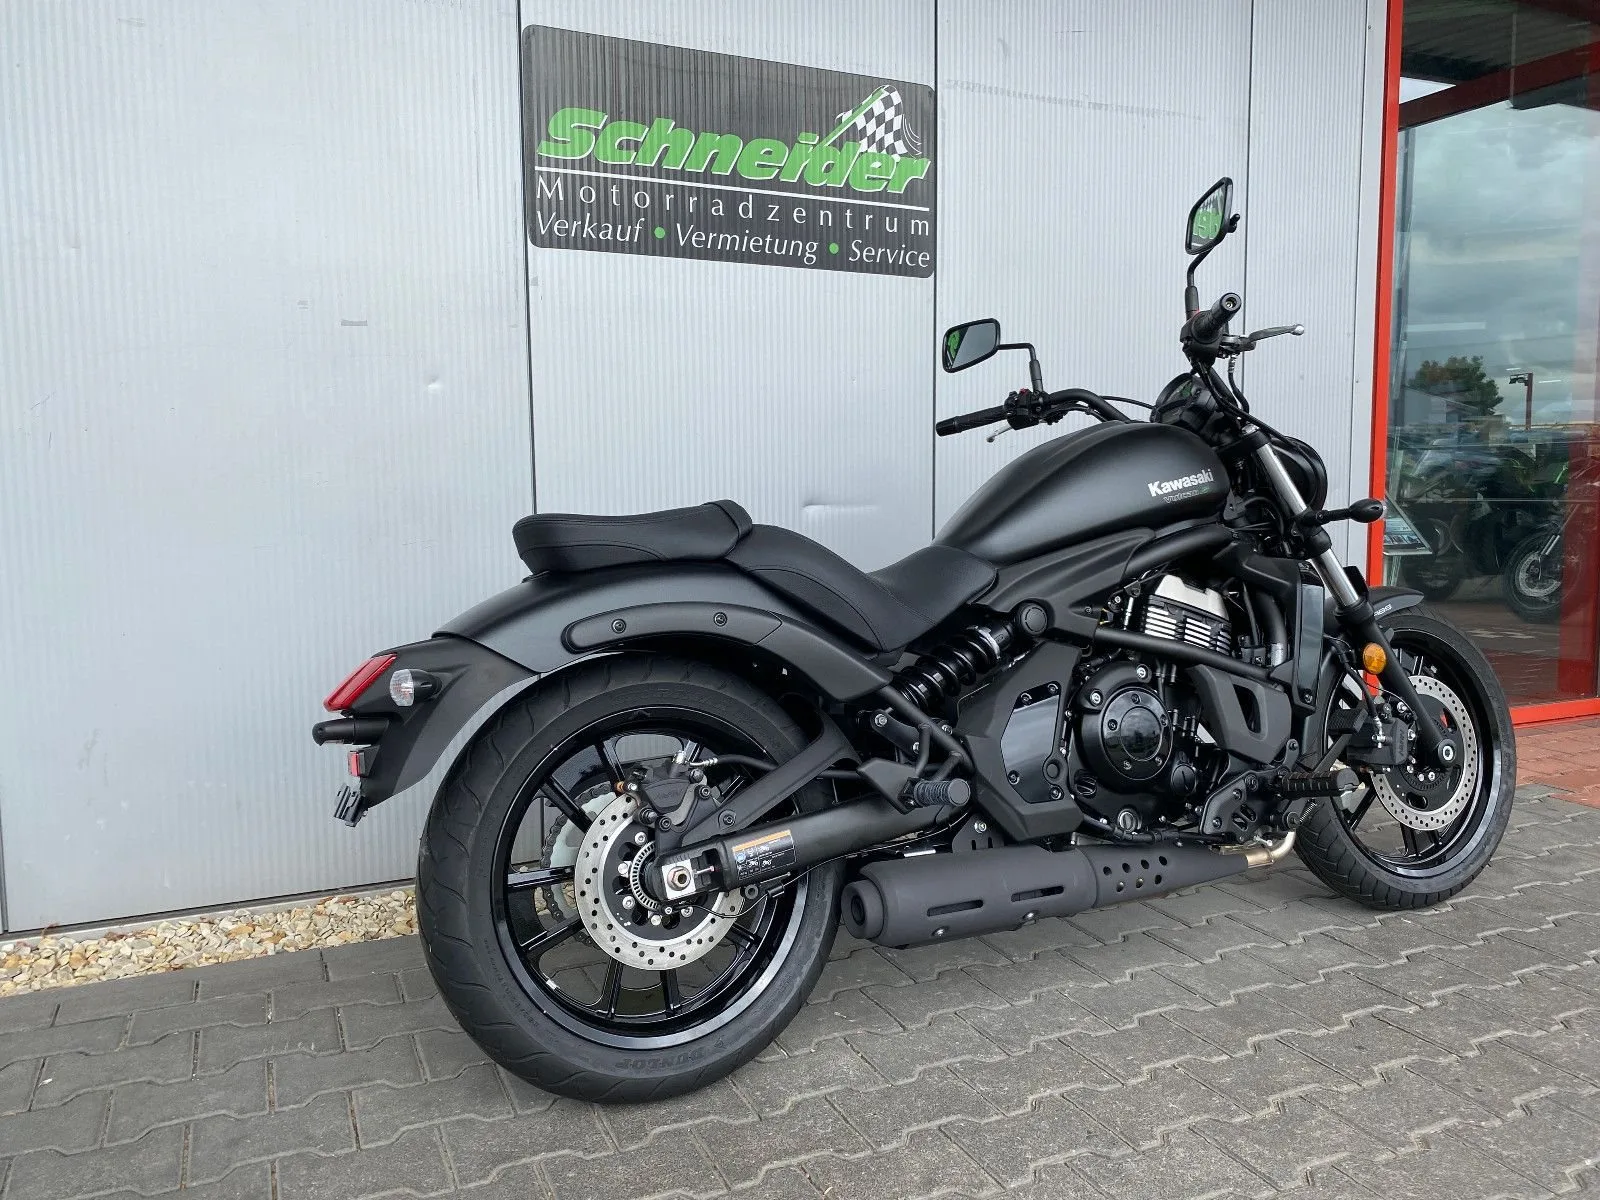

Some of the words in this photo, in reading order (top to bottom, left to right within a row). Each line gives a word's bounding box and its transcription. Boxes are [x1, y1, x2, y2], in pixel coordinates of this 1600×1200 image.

[537, 107, 931, 194] Schneider
[536, 176, 929, 236] Motorradzentrum
[536, 211, 645, 243] Verkauf
[676, 223, 819, 264] Vermietung
[849, 239, 931, 268] Service
[1147, 468, 1215, 497] Kawasaki
